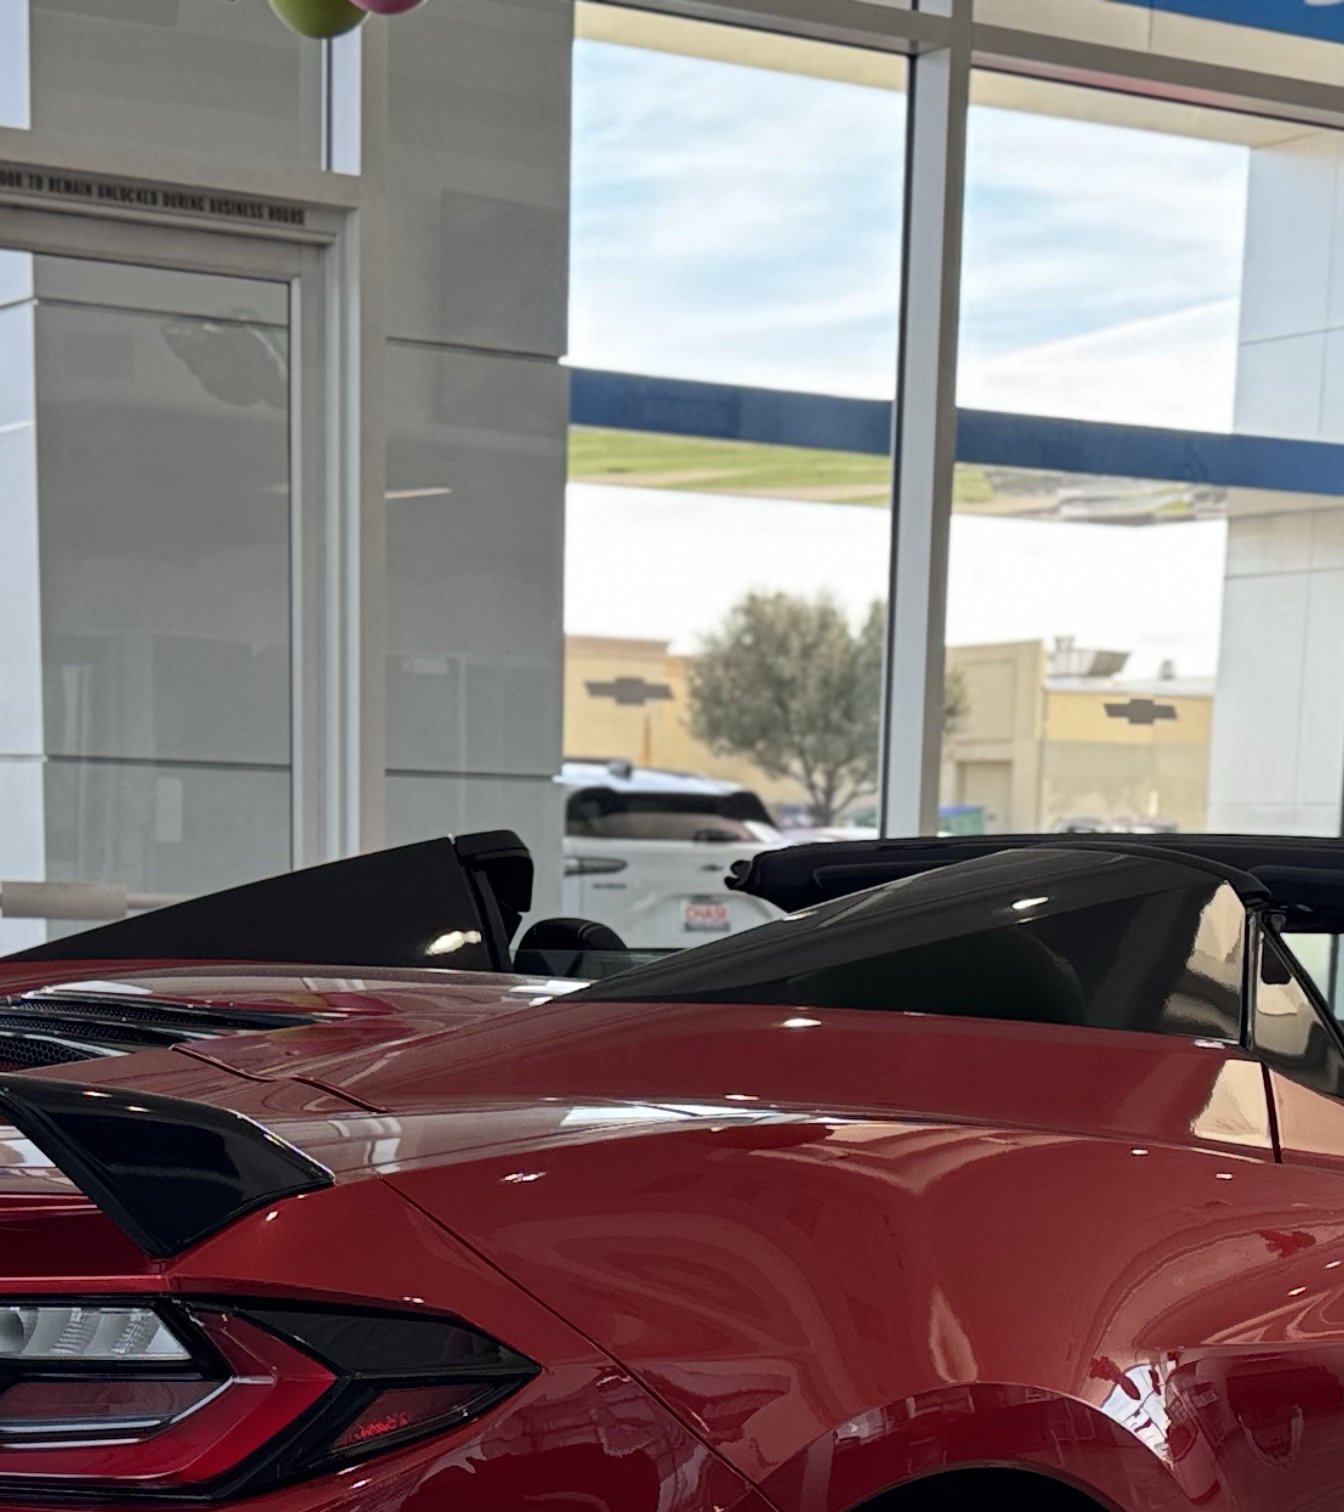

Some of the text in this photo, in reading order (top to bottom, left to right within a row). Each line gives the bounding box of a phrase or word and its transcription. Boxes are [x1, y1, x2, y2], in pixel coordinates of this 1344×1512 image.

[29, 173, 44, 192] TO
[49, 177, 93, 197] REMAIN
[98, 183, 158, 206] UNLOCKED
[162, 191, 206, 213] DURING
[209, 198, 264, 221] BUSINESS
[268, 206, 305, 225] HOURS
